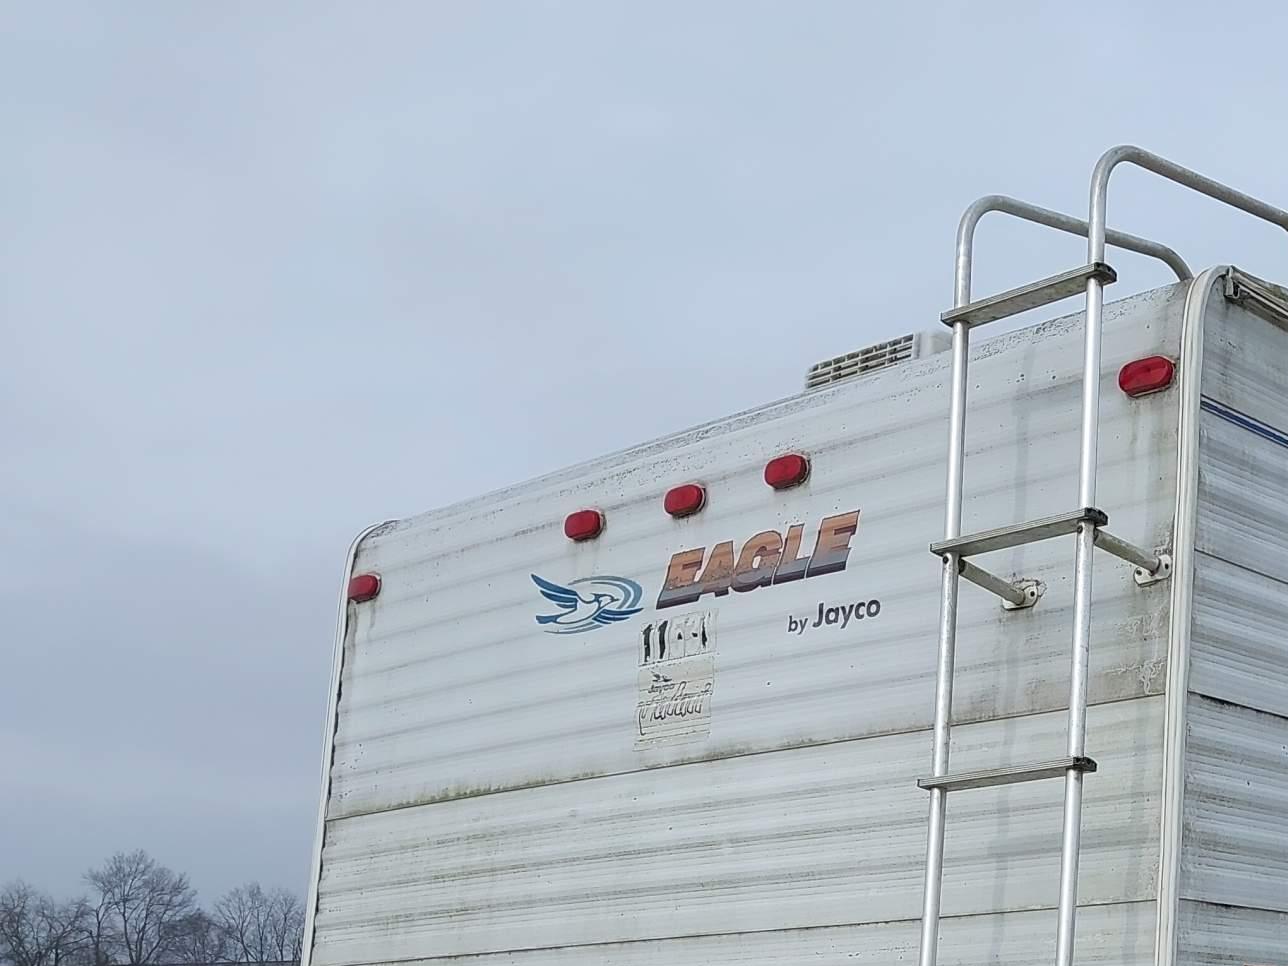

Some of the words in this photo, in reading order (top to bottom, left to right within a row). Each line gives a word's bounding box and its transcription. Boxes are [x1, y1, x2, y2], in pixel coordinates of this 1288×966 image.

[656, 509, 861, 610] EAGLE
[788, 615, 808, 635] by
[812, 599, 881, 630] Jayco
